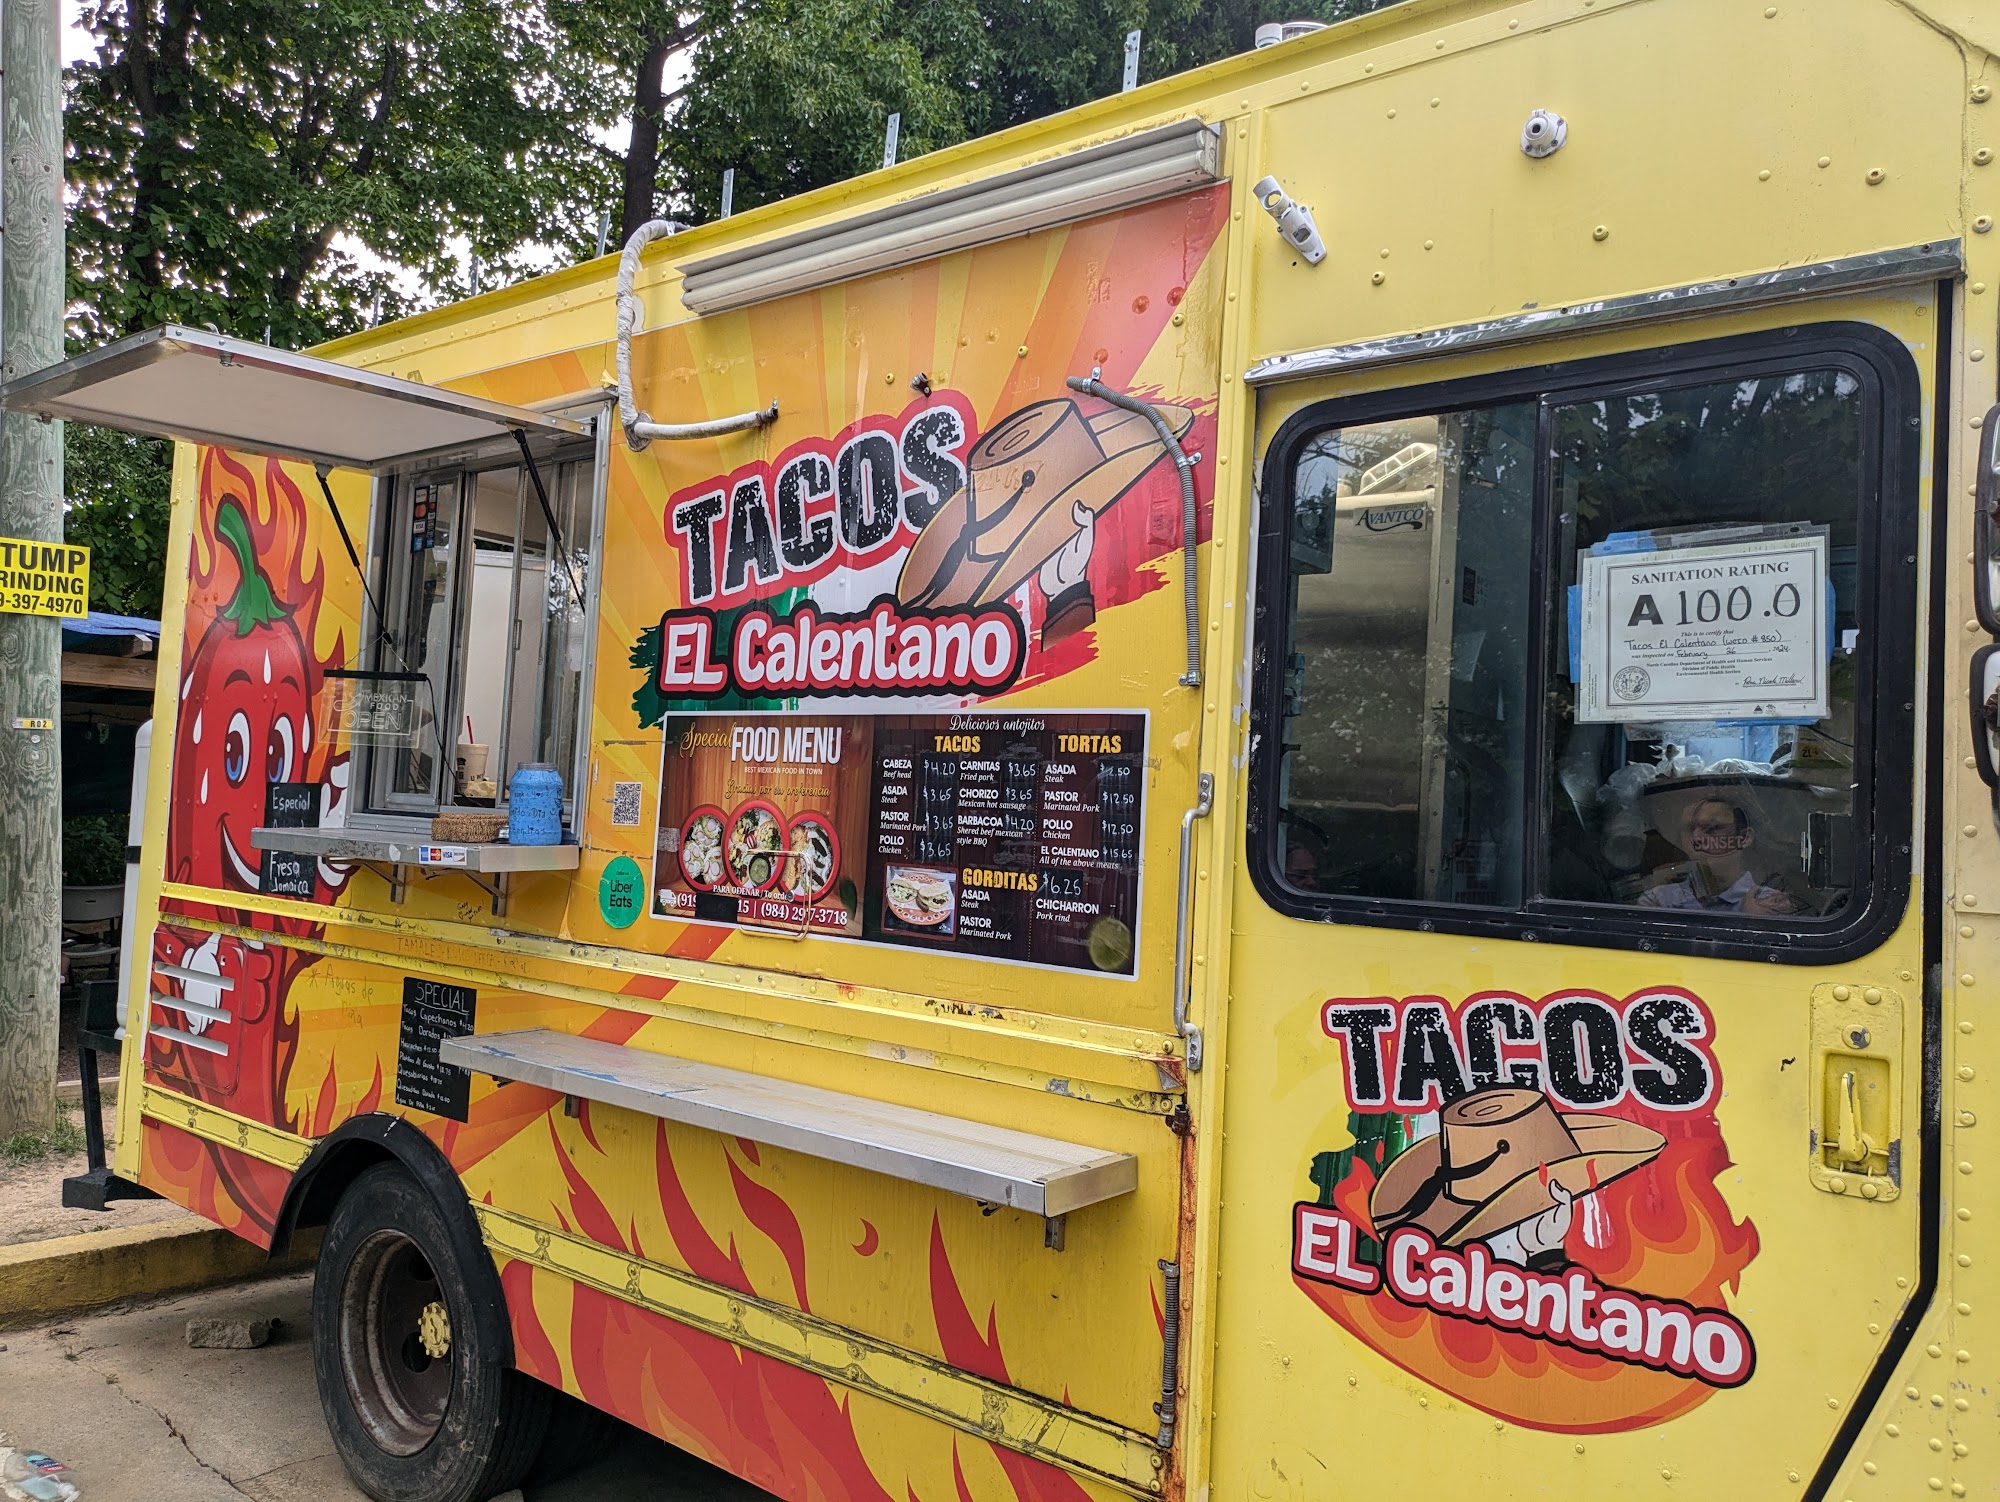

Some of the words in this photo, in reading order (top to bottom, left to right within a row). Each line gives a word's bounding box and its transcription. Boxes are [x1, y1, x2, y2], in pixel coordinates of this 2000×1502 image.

[675, 404, 967, 604] TACOS
[1355, 508, 1424, 527] AVANTCO
[0, 542, 86, 574] TUMP
[1631, 567, 1724, 585] SANITATION
[1728, 561, 1789, 577] RATING
[0, 570, 84, 595] RINDING
[0, 592, 83, 614] 9-397-4970
[1627, 593, 1664, 627] A
[1676, 583, 1801, 626] 100.0
[663, 621, 727, 688] EL
[735, 607, 1012, 685] Calentano
[1624, 640, 1653, 652] Tacos
[1659, 640, 1668, 649] El
[1674, 638, 1717, 650] Calentano
[1676, 650, 1708, 660] February
[364, 692, 408, 703] MEXICAN
[370, 702, 399, 711] FOOD
[343, 709, 401, 731] OPEN
[950, 714, 1000, 731] Deliciosos
[1003, 717, 1045, 738] antojitos
[679, 722, 737, 759] Special
[731, 726, 780, 763] FOOD
[782, 726, 843, 765] MENU
[934, 735, 981, 753] TACOS
[1058, 735, 1122, 754] TORTAS
[782, 767, 798, 775] FOOD
[798, 767, 805, 775] IN
[883, 759, 912, 769] CABEZA
[924, 759, 956, 776] $4.20
[960, 761, 1001, 772] CARNITAS
[1008, 762, 1037, 777] $3.65
[1045, 765, 1077, 775] ASADA
[883, 770, 896, 779] Beef
[896, 771, 912, 779] head
[960, 772, 978, 781] Fried
[978, 773, 995, 783] pork
[1044, 775, 1064, 784] Steak
[725, 778, 757, 799] Gracias
[755, 786, 772, 801] por
[784, 782, 832, 802] preferencia
[881, 785, 908, 796] ASADA
[923, 785, 952, 802] $3.65
[959, 788, 999, 799] CHORIZO
[1006, 787, 1033, 801] $3.65
[1044, 791, 1079, 802] PASTOR
[272, 786, 311, 812] Especial
[880, 796, 898, 804] Steak
[1102, 791, 1135, 804] $12.50
[958, 800, 986, 808] Mexican
[986, 800, 998, 809] hot
[999, 802, 1027, 811] sausage
[1042, 802, 1081, 812] Marinated
[1081, 804, 1100, 813] Pork
[880, 811, 909, 822] PASTOR
[925, 812, 954, 830] $3.65
[957, 815, 1003, 828] BARBACOA
[1005, 814, 1035, 831] $4.20
[880, 821, 911, 831] Marinated
[911, 823, 927, 832] Pork
[1043, 819, 1073, 831] POLLO
[1101, 819, 1134, 835] $12.50
[956, 827, 980, 836] Shered
[980, 827, 995, 837] beef
[994, 830, 1023, 838] mexican
[1042, 830, 1071, 840] Chicken
[879, 835, 905, 846] POLLO
[956, 837, 972, 846] style
[972, 837, 988, 848] BBQ
[1693, 834, 1746, 851] SUNSET
[878, 846, 902, 854] Chicken
[920, 838, 952, 858] $3.65
[1041, 845, 1049, 855] EL
[1051, 846, 1100, 859] CALENTANO
[1102, 845, 1133, 859] $15.65
[269, 851, 300, 880] Fresa
[1039, 857, 1050, 865] All
[1050, 857, 1059, 867] of
[1060, 857, 1072, 866] the
[1072, 858, 1095, 868] above
[1095, 860, 1119, 870] meats
[270, 878, 311, 895] Jamaica
[610, 879, 633, 893] Uber
[962, 867, 1038, 892] GORDITAS
[1043, 870, 1082, 896] $6.25
[712, 884, 730, 894] PARA
[764, 889, 773, 899] To
[961, 888, 991, 902] ASADA
[609, 894, 633, 908] Eats
[960, 900, 980, 909] Steak
[1035, 898, 1100, 915] CHICHARRON
[761, 901, 790, 921] (984)
[1036, 911, 1054, 921] Pork
[1054, 912, 1071, 923] rind
[960, 915, 992, 929] PASTOR
[959, 927, 995, 939] Marinated
[995, 931, 1012, 941] Pork
[415, 981, 470, 1013] SPECIAL
[1331, 998, 1708, 1105] TACOS
[1299, 1209, 1374, 1286] EL
[1391, 1234, 1743, 1376] Calentano
